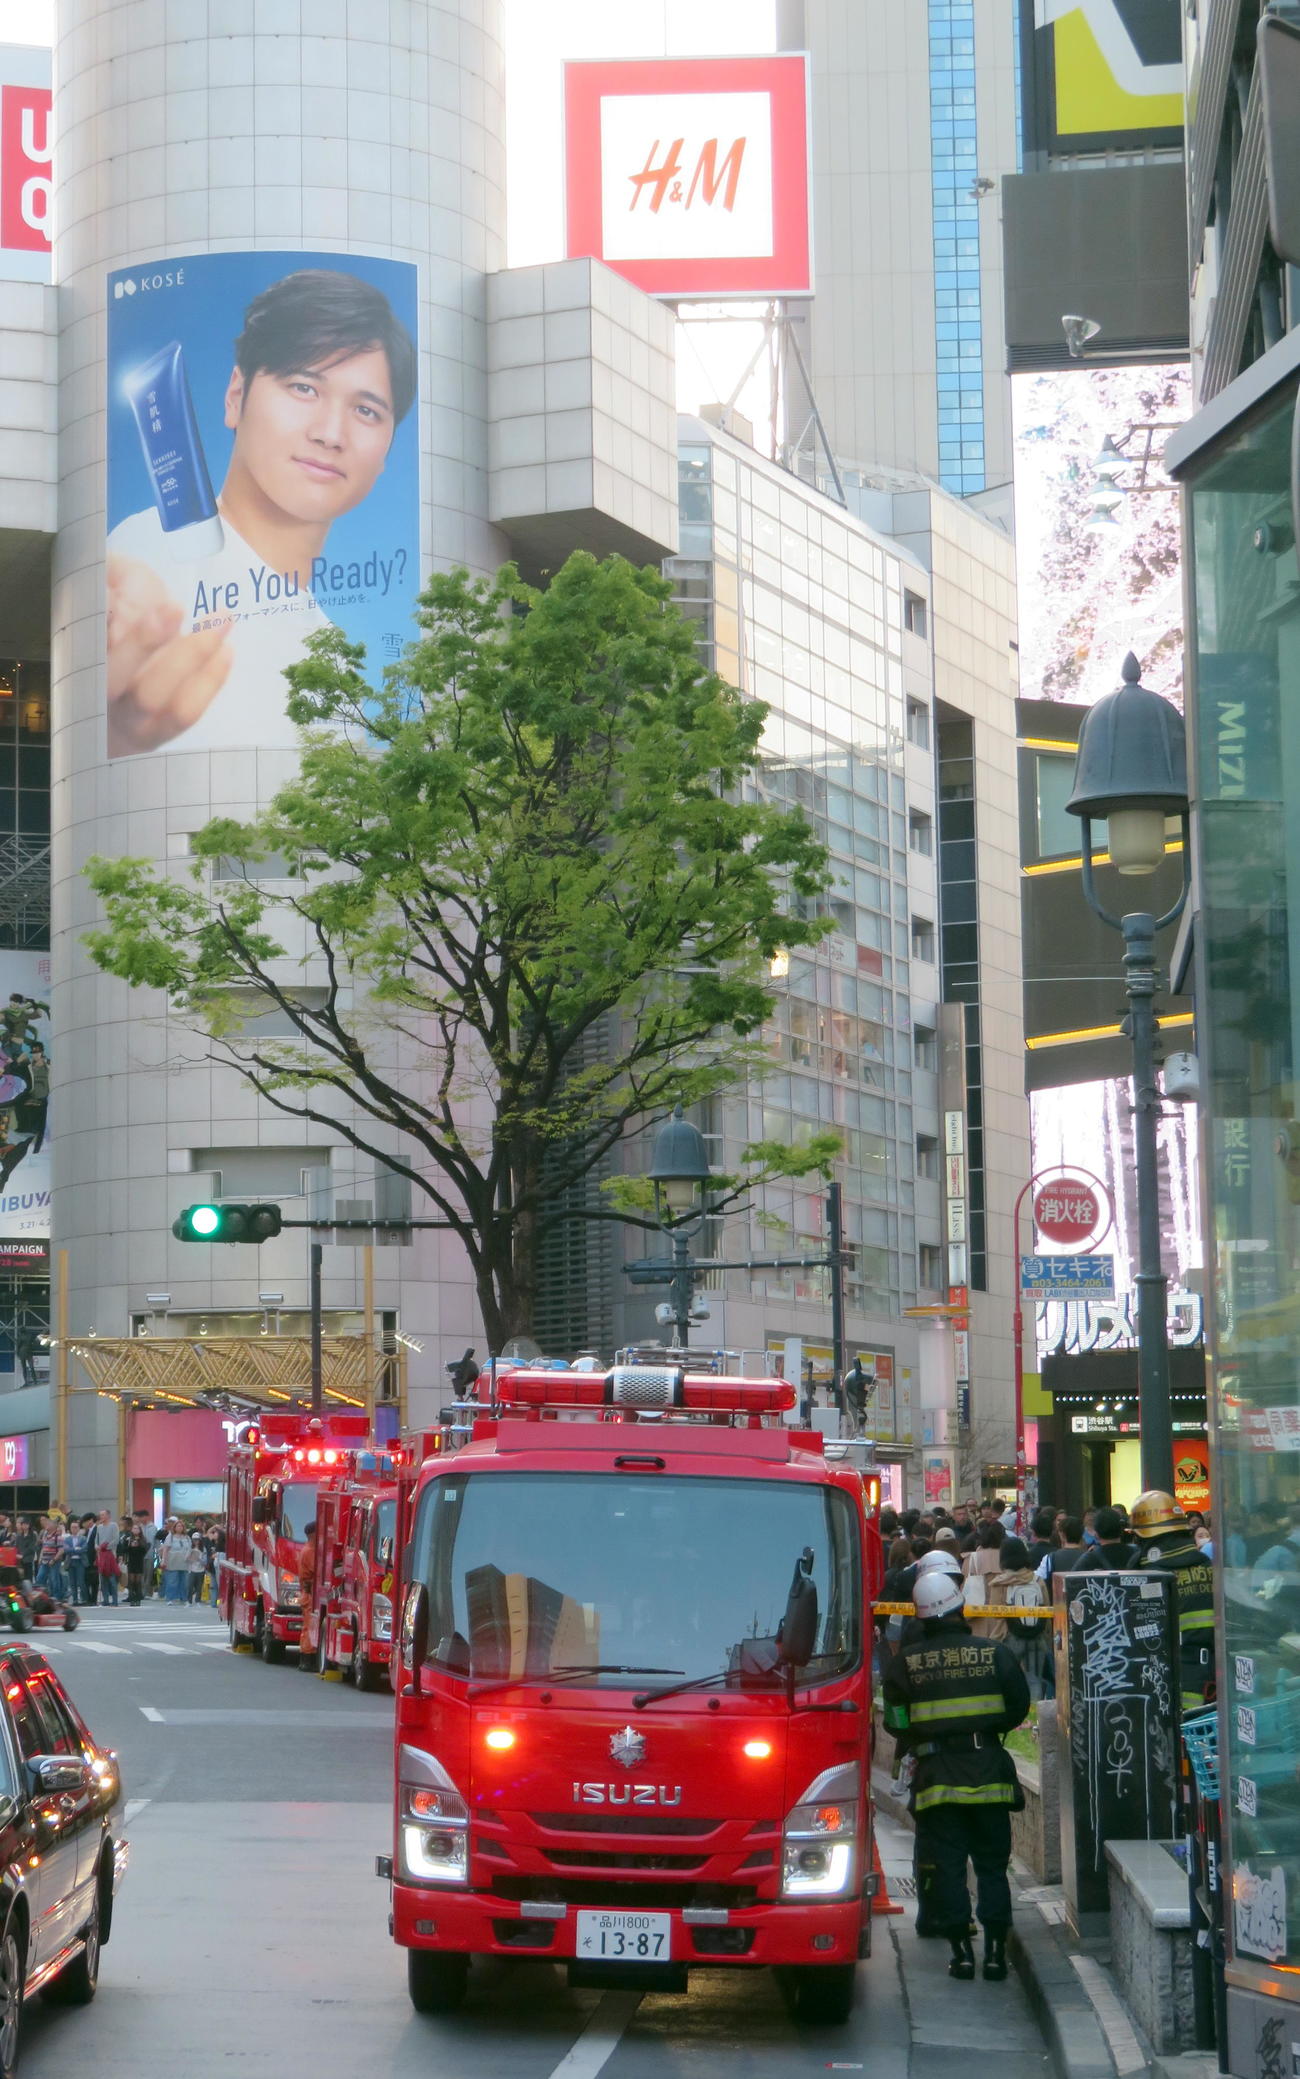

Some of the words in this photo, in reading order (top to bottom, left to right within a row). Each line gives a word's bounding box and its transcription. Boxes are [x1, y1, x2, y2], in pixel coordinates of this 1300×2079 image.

[628, 137, 746, 214] H&M
[141, 268, 185, 291] KOSÉ
[147, 391, 162, 433] 雪肌精
[193, 580, 239, 618] Are
[248, 566, 299, 603] You
[311, 548, 408, 597] Ready?
[1039, 1198, 1094, 1224] 消火栓
[1046, 1256, 1113, 1279] セキネ
[1088, 1416, 1113, 1425] 渋谷駅
[1088, 1425, 1106, 1433] Shibuya
[905, 1646, 996, 1672] 東京消防庁
[910, 1671, 943, 1684] TOKYO
[943, 1668, 967, 1681] FIRE
[573, 1782, 682, 1806] ISUZU
[600, 1931, 665, 1957] 13-87
